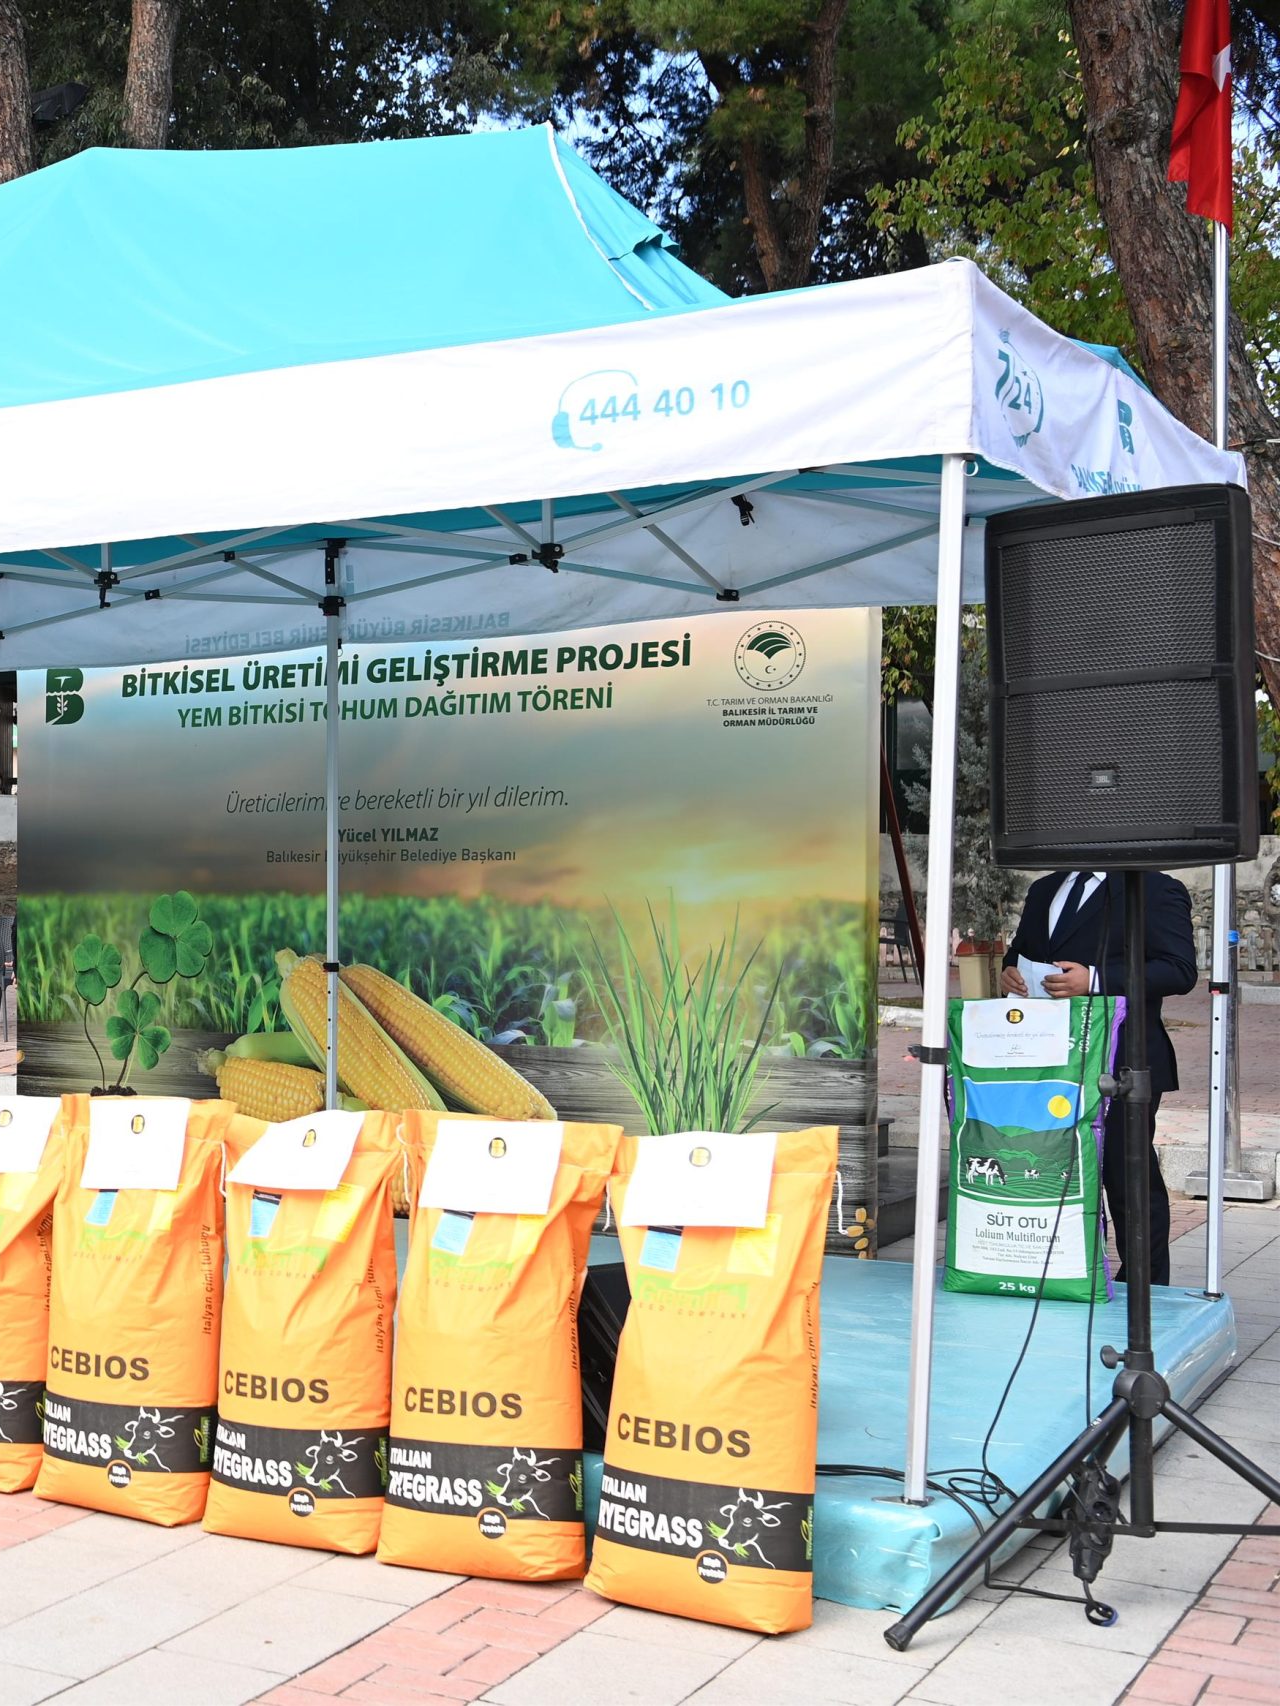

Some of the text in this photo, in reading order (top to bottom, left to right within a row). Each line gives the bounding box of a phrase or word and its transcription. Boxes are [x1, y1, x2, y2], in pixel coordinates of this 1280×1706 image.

[579, 379, 751, 426] 444 40 10
[122, 664, 235, 698] BİTKİSEL
[366, 647, 548, 686] GELİŞTİRME
[556, 633, 691, 673] PROJESİ
[178, 705, 222, 728] YEM
[228, 698, 304, 725] BİTKİSİ
[405, 690, 511, 718] DAĞITIM
[517, 681, 613, 712] TÖRENİ
[721, 698, 745, 706] TARIM
[746, 697, 756, 705] VE
[758, 696, 789, 704] ORMAN
[790, 693, 833, 704] BAKANLIĞI
[722, 705, 818, 717] BALIKESİR İL TARIM VE
[723, 716, 815, 727] ORMAN MÜDÜRLÜĞÜ
[354, 785, 569, 814] bereketli bir yıl dilerim.
[338, 827, 439, 843] Yücel YILMAZ
[266, 848, 516, 865] Balıkesir Belediye Başkanı
[975, 1227, 1061, 1243] Lolium Multiflorum
[986, 1212, 1048, 1230] SÜT OTU
[999, 1281, 1036, 1294] 25 kg
[51, 1345, 150, 1381] CEBIOS
[224, 1369, 330, 1404] CEBIOS
[404, 1386, 523, 1420] CEBIOS
[617, 1412, 752, 1459] CEBIOS
[390, 1447, 432, 1470] ITALIAN
[388, 1470, 484, 1508] RYEGRASS
[601, 1474, 648, 1504] ITALIAN
[598, 1498, 703, 1549] RYEGRASS
